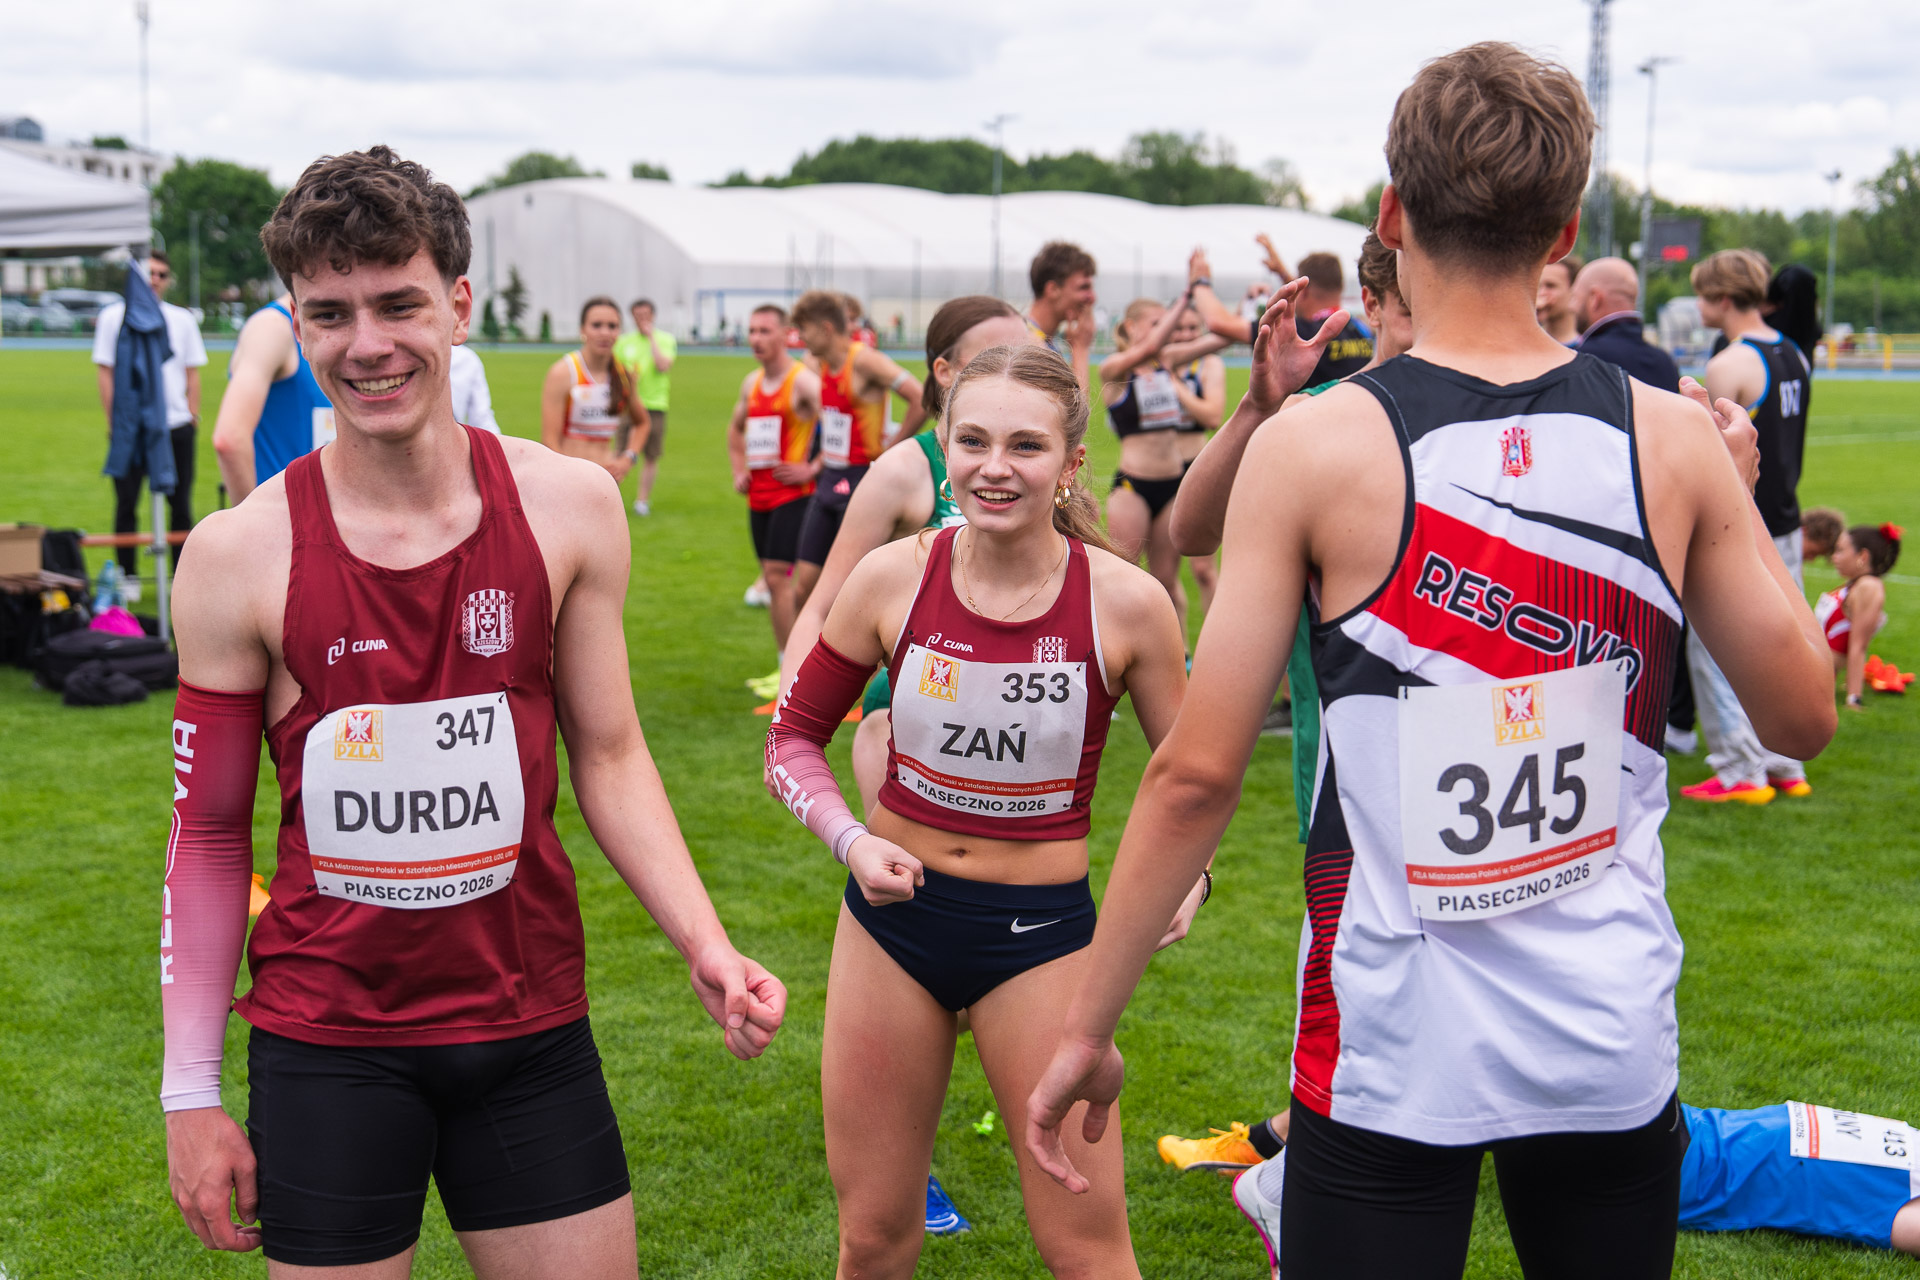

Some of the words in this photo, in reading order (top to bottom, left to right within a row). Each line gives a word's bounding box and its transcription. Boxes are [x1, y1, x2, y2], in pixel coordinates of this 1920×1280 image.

[470, 597, 505, 608] RESOVIA
[351, 638, 389, 653] CUNA
[943, 639, 974, 653] CUNA
[921, 683, 954, 700] PZLA
[1001, 672, 1070, 704] 353
[436, 706, 495, 750] 347
[1500, 722, 1542, 742] PZLA
[337, 743, 380, 759] PZLA
[939, 722, 1027, 763] ZAŃ
[917, 779, 1004, 812] PIASECZNO
[1007, 799, 1046, 812] 2026
[941, 777, 957, 785] Polski
[964, 782, 996, 791] Sztafetach
[334, 781, 501, 835] DURDA
[1436, 742, 1587, 855] 345
[319, 860, 334, 868] PZLA
[334, 863, 374, 872] Mistrzostwa
[376, 866, 396, 874] Polski
[406, 864, 445, 874] Sztafetach
[446, 858, 482, 870] Mieszanych
[344, 881, 456, 901] PIASECZNO
[459, 874, 495, 896] 2026
[1437, 878, 1550, 912] PIASECZNO
[1555, 863, 1590, 889] 2026
